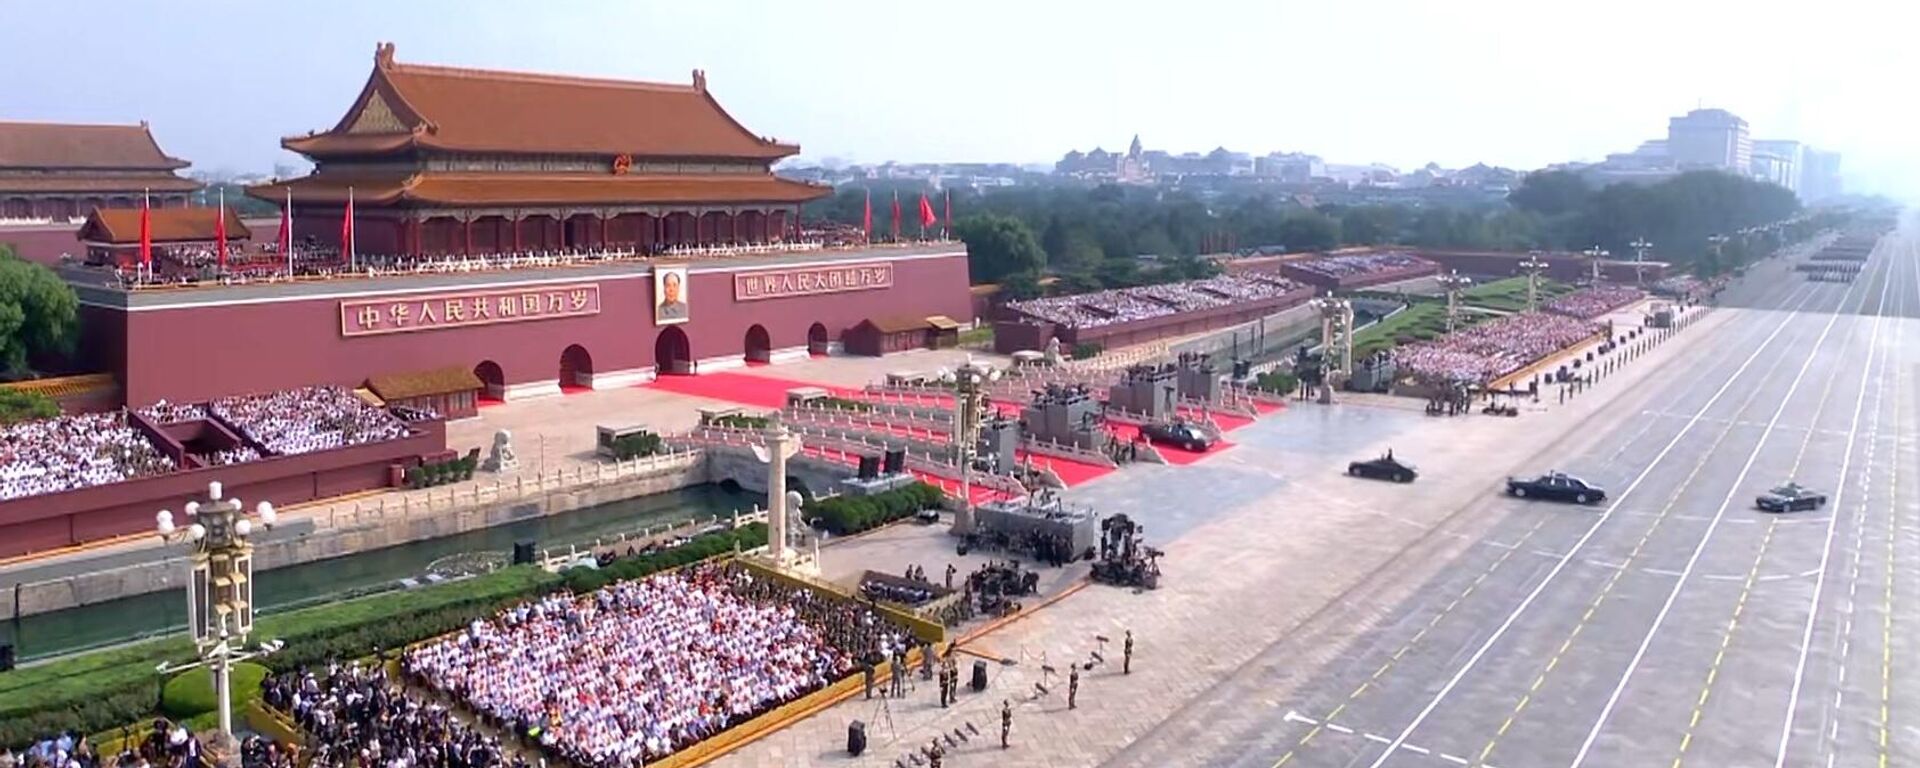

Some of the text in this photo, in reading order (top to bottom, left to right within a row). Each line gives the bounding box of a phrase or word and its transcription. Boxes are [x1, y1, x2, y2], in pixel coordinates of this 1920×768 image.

[746, 269, 886, 295] 世界人民大团结万岁
[358, 290, 588, 329] 中华人民共和国万岁
